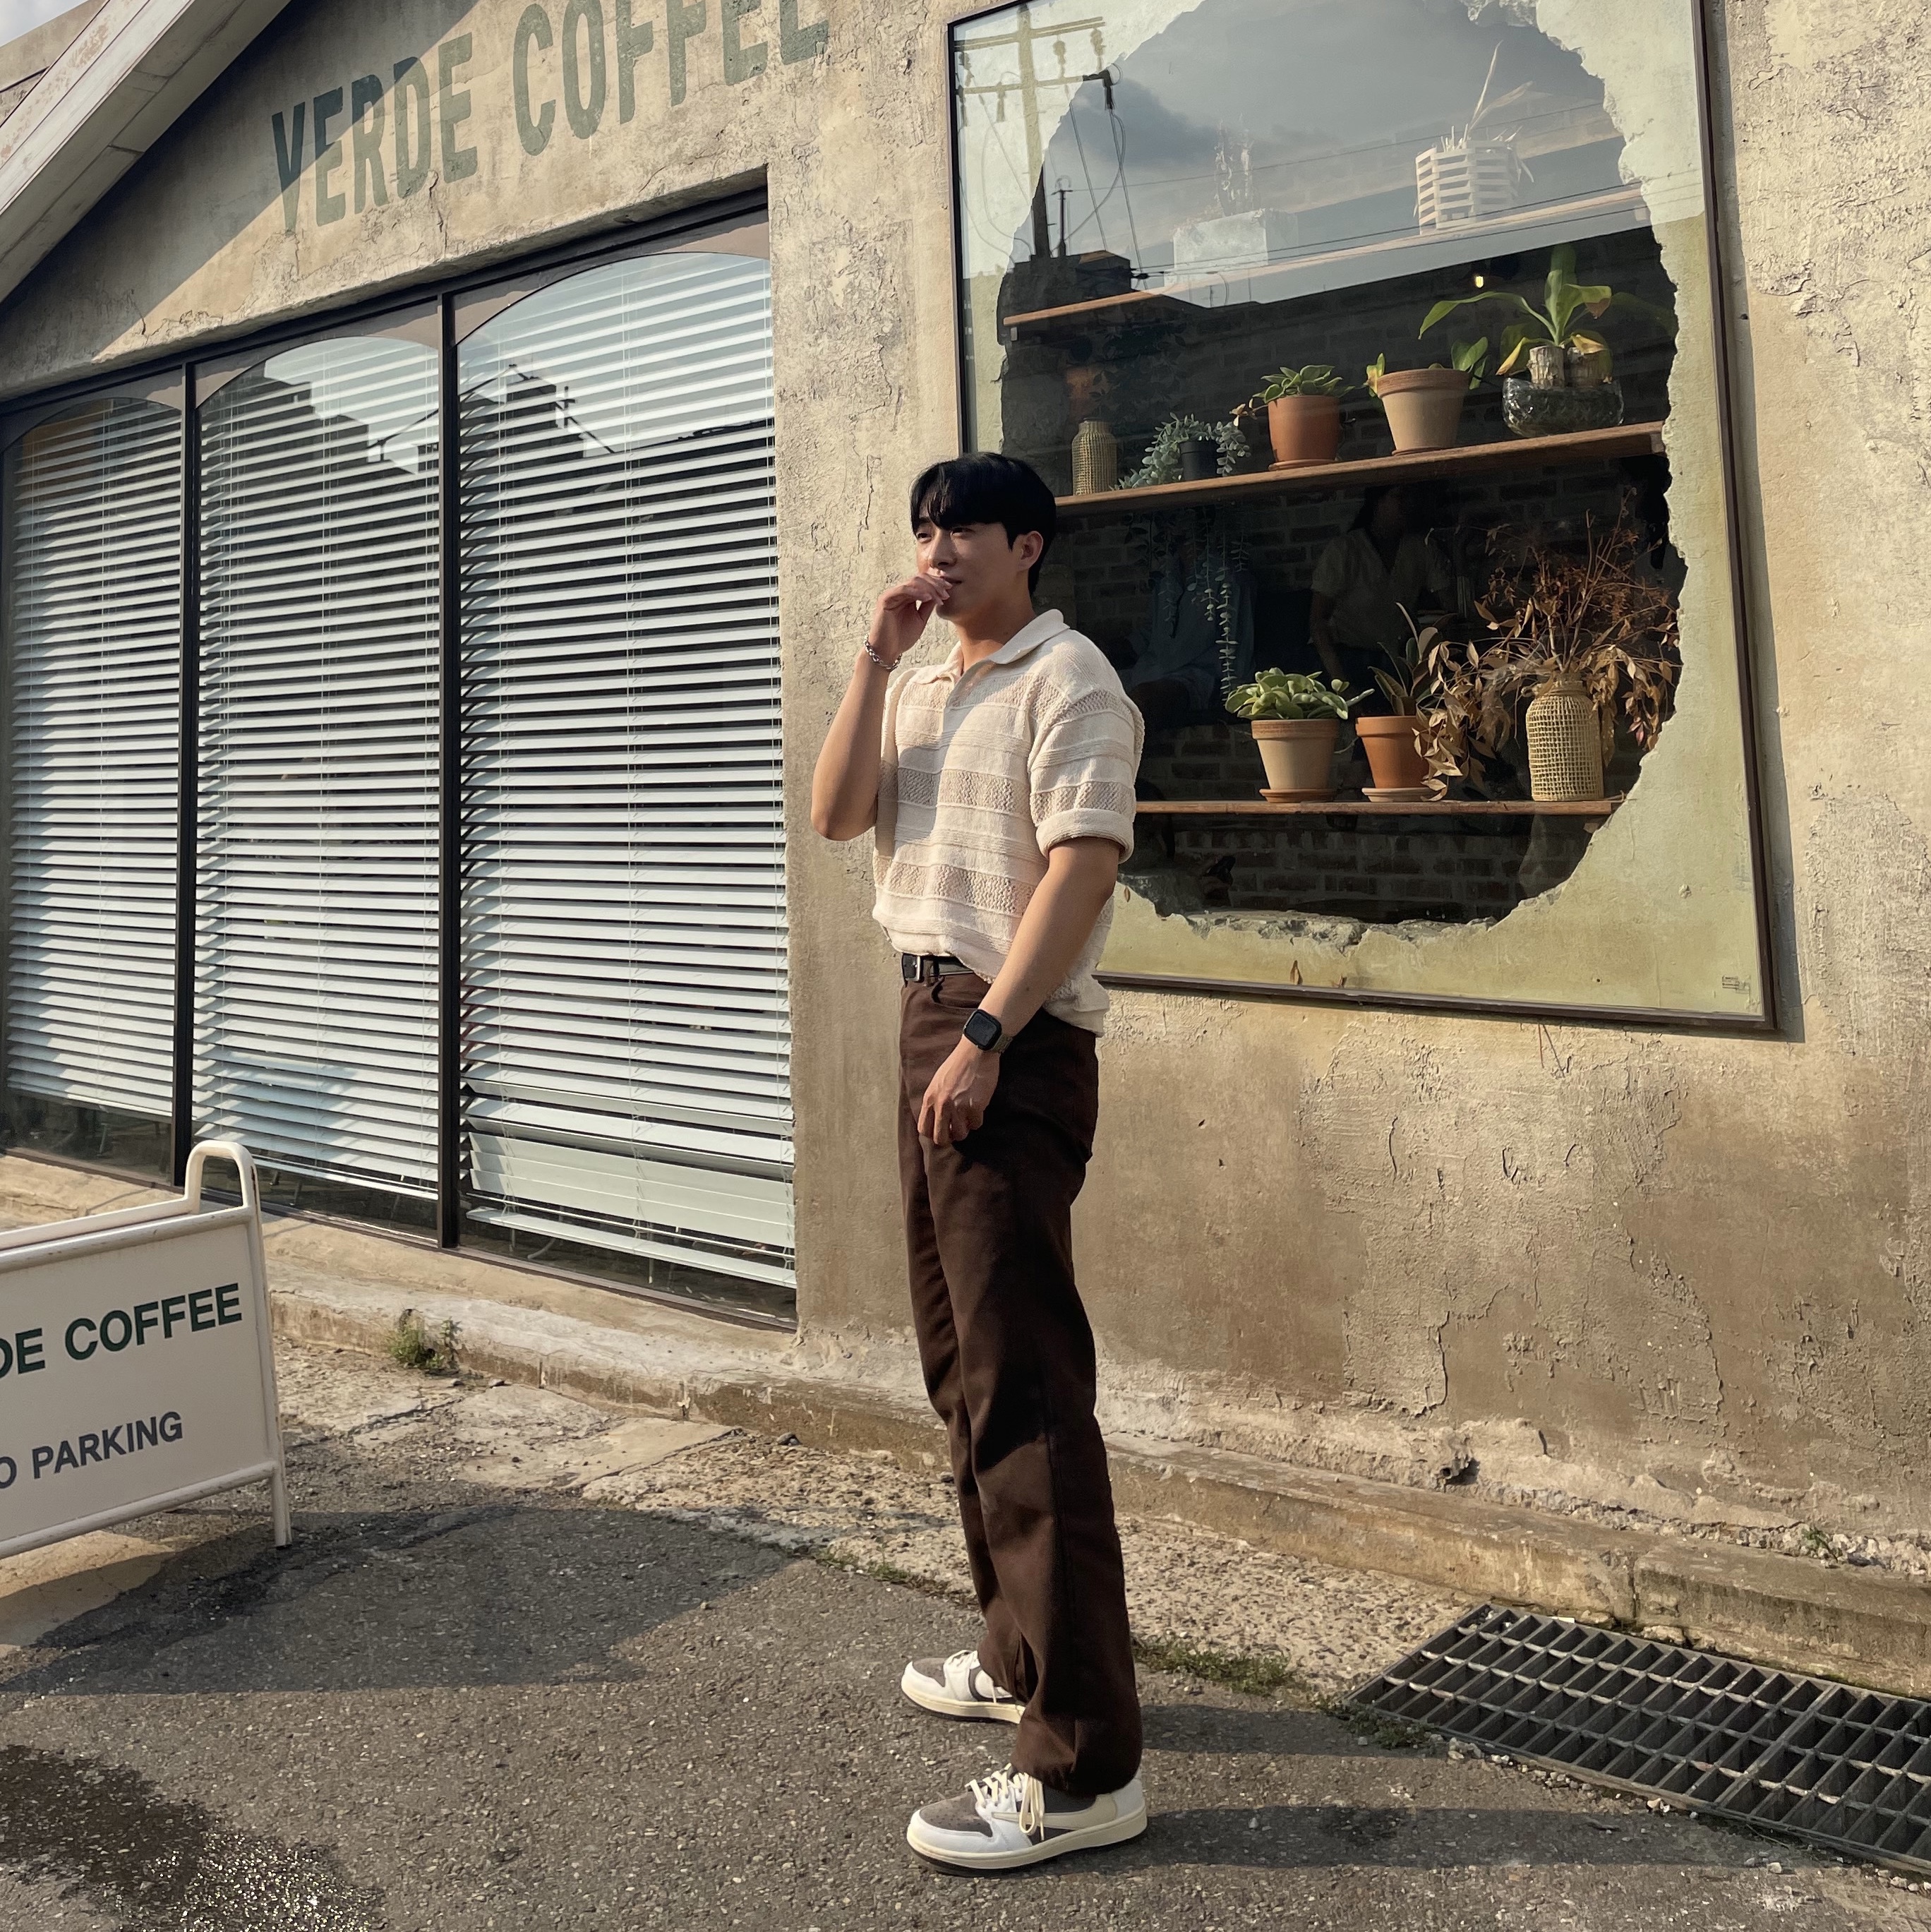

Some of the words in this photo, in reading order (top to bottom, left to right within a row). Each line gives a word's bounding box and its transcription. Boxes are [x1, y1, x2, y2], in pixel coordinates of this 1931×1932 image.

[272, 32, 479, 235] VERDE
[65, 1283, 242, 1360] COFFEE
[32, 1412, 183, 1480] PARKING
